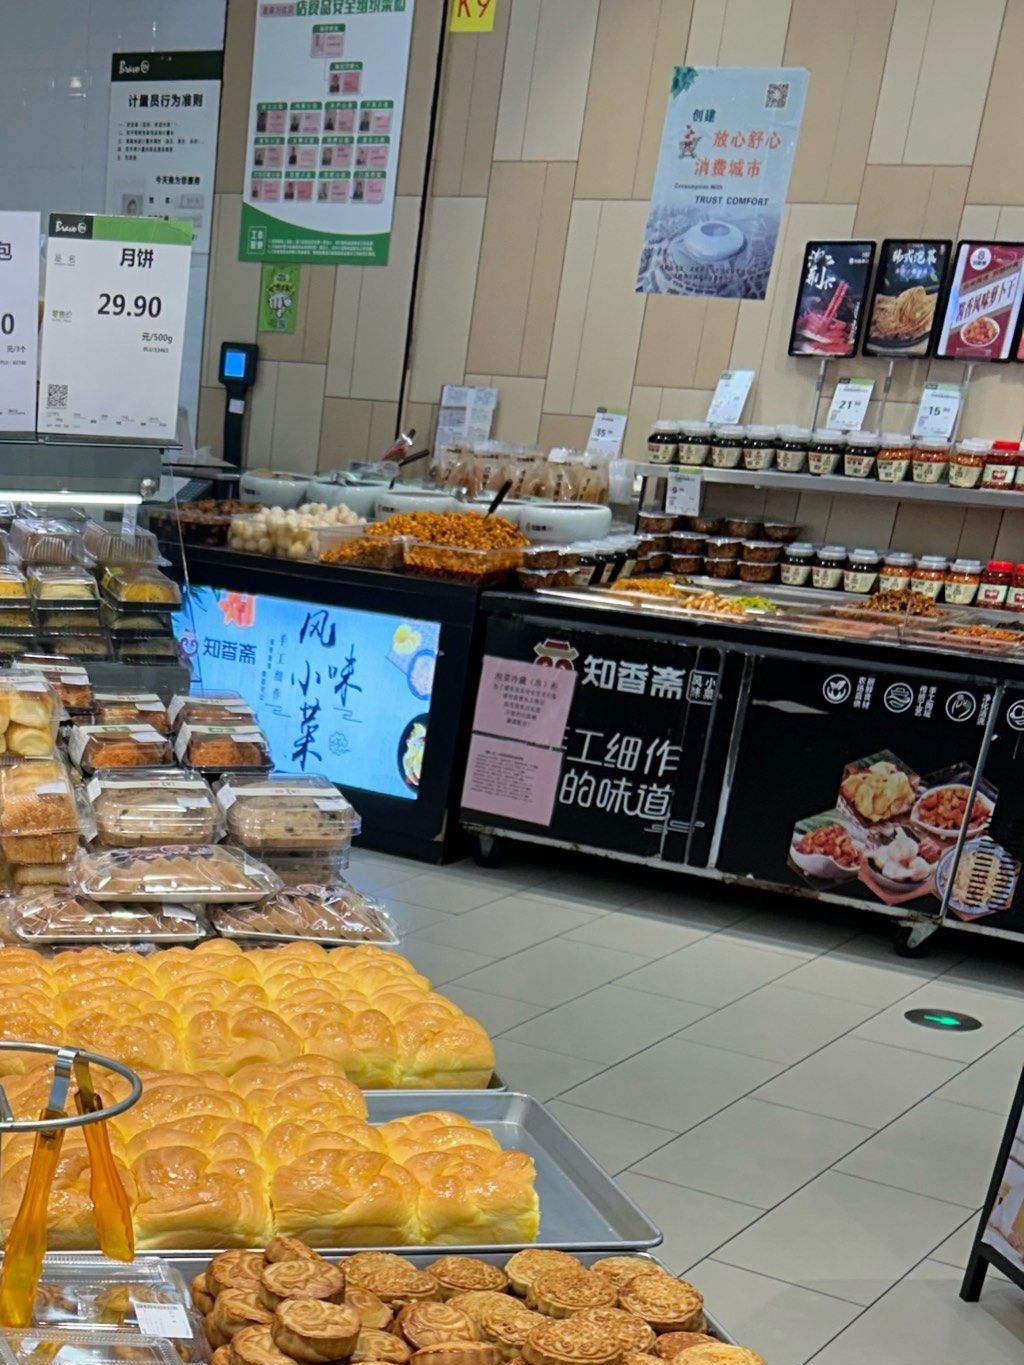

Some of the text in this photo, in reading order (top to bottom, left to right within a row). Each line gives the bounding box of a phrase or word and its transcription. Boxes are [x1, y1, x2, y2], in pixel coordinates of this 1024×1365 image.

[128, 94, 203, 108] 计量员行为准则
[692, 108, 716, 123] 创建
[713, 131, 781, 149] 放心舒心
[693, 159, 762, 177] 消费城市
[695, 195, 769, 206] TRUST COMFORT
[120, 248, 154, 268] 月饼
[97, 293, 162, 319] 29.90
[141, 332, 173, 344] 元/500g
[838, 400, 852, 410] 21
[929, 406, 941, 416] 15
[202, 637, 257, 665] 知香斋
[582, 655, 687, 700] 知香斋
[563, 726, 684, 778] 工细作
[558, 769, 675, 821] 的味道
